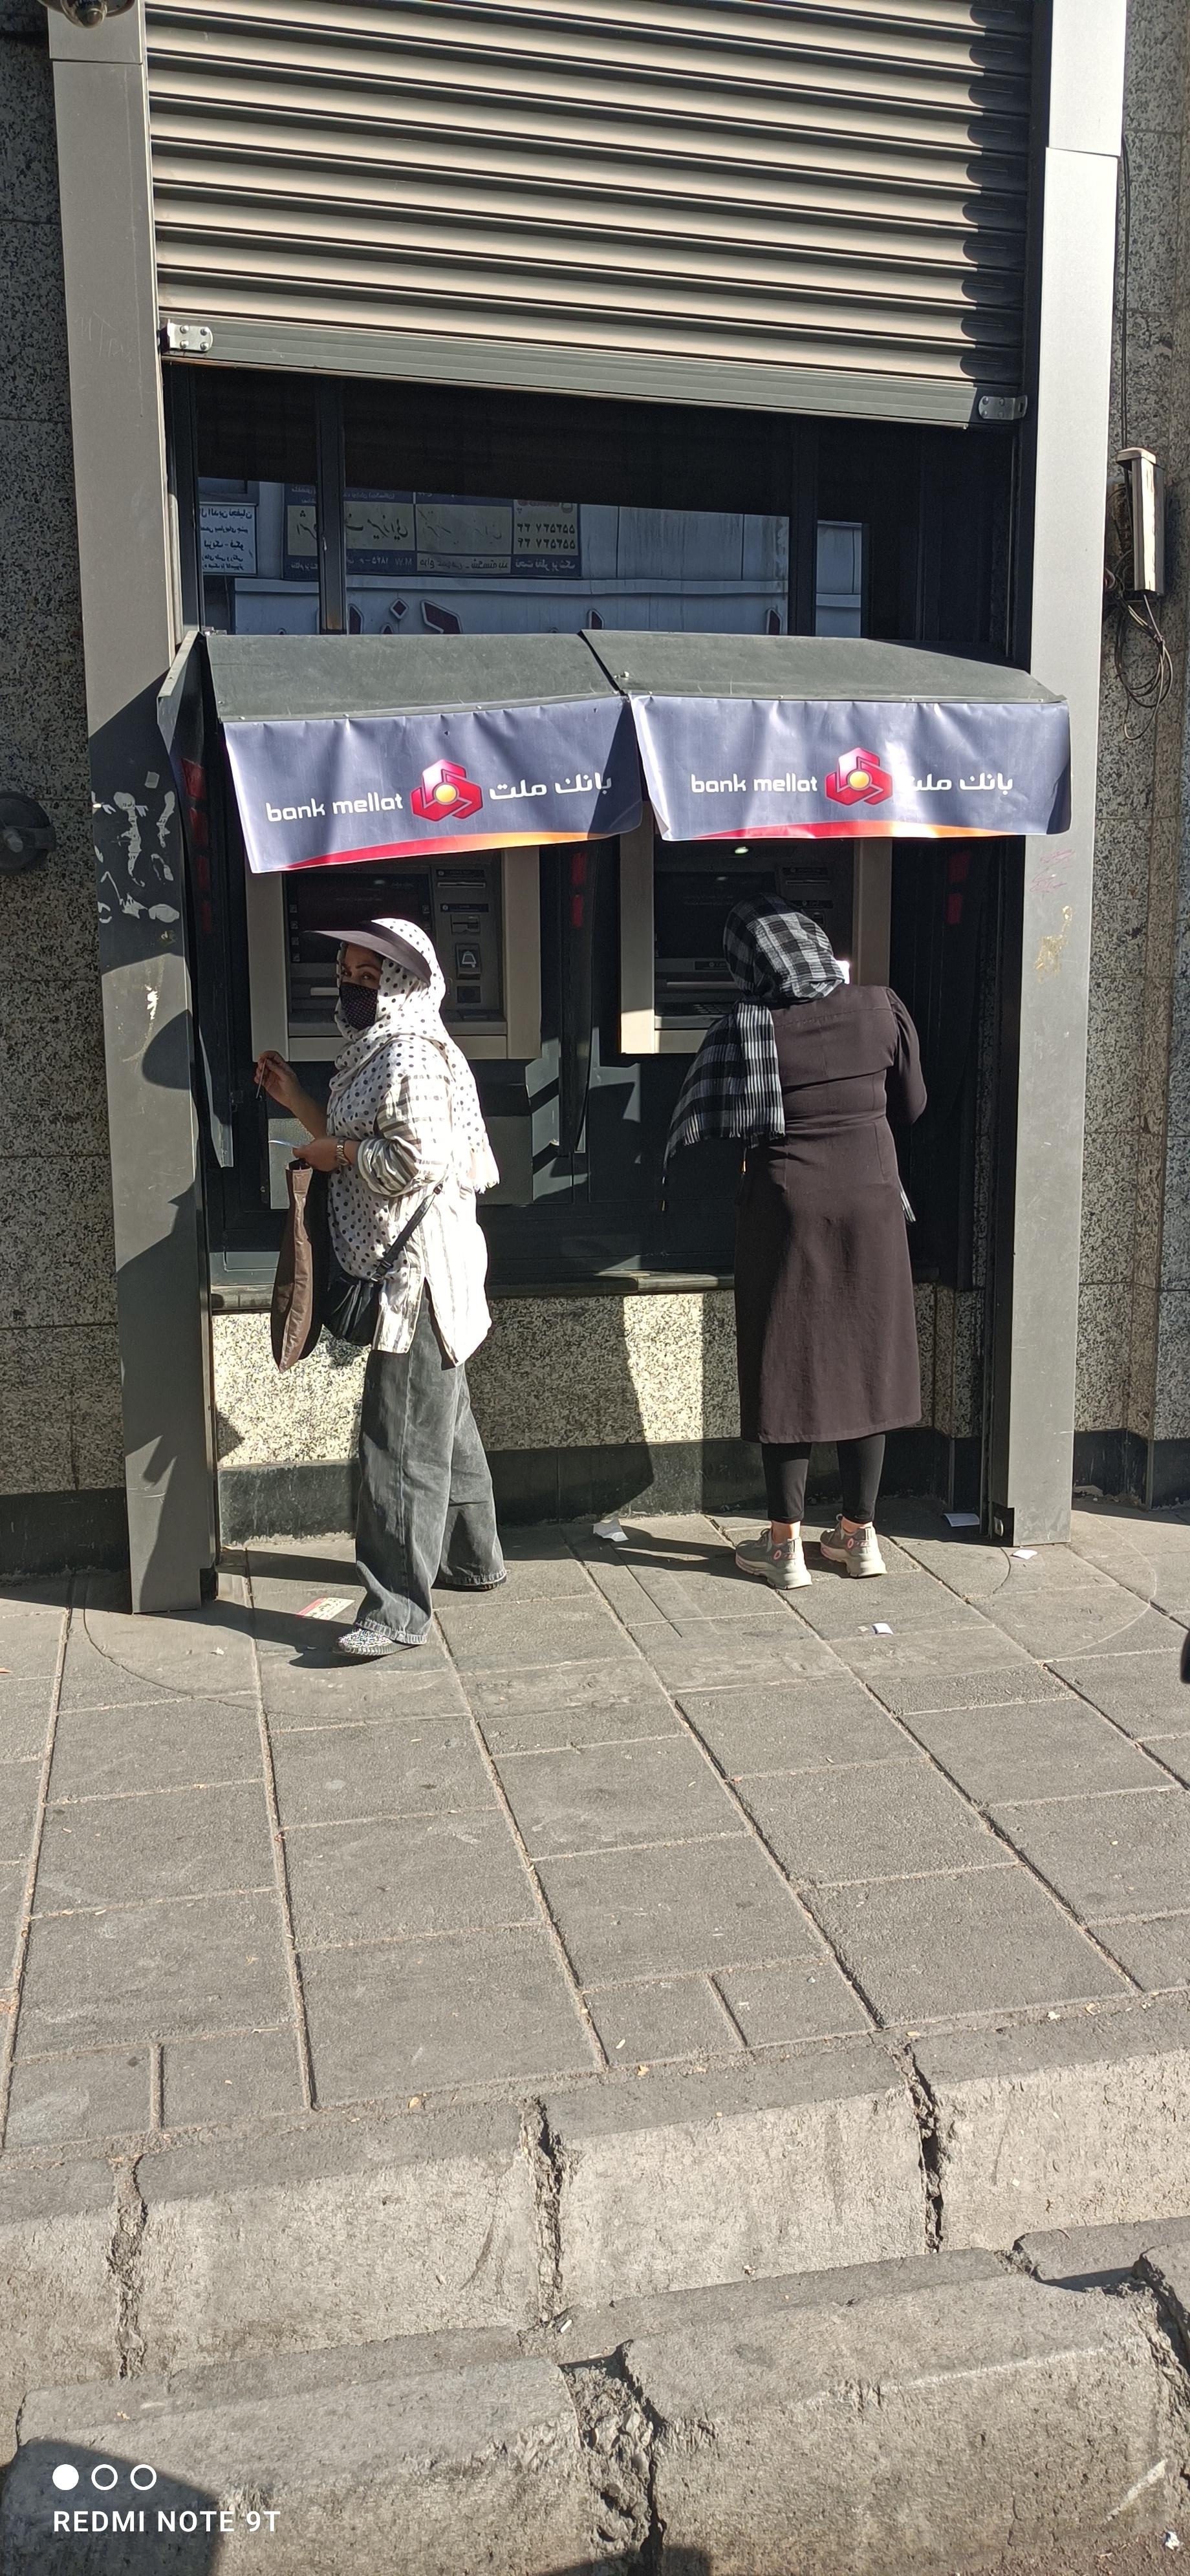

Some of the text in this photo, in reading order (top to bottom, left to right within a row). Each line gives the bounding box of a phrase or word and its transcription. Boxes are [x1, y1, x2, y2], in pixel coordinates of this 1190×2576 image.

[489, 778, 547, 800] ملت
[690, 773, 817, 794] bank mellat
[266, 792, 404, 822] bank mellat
